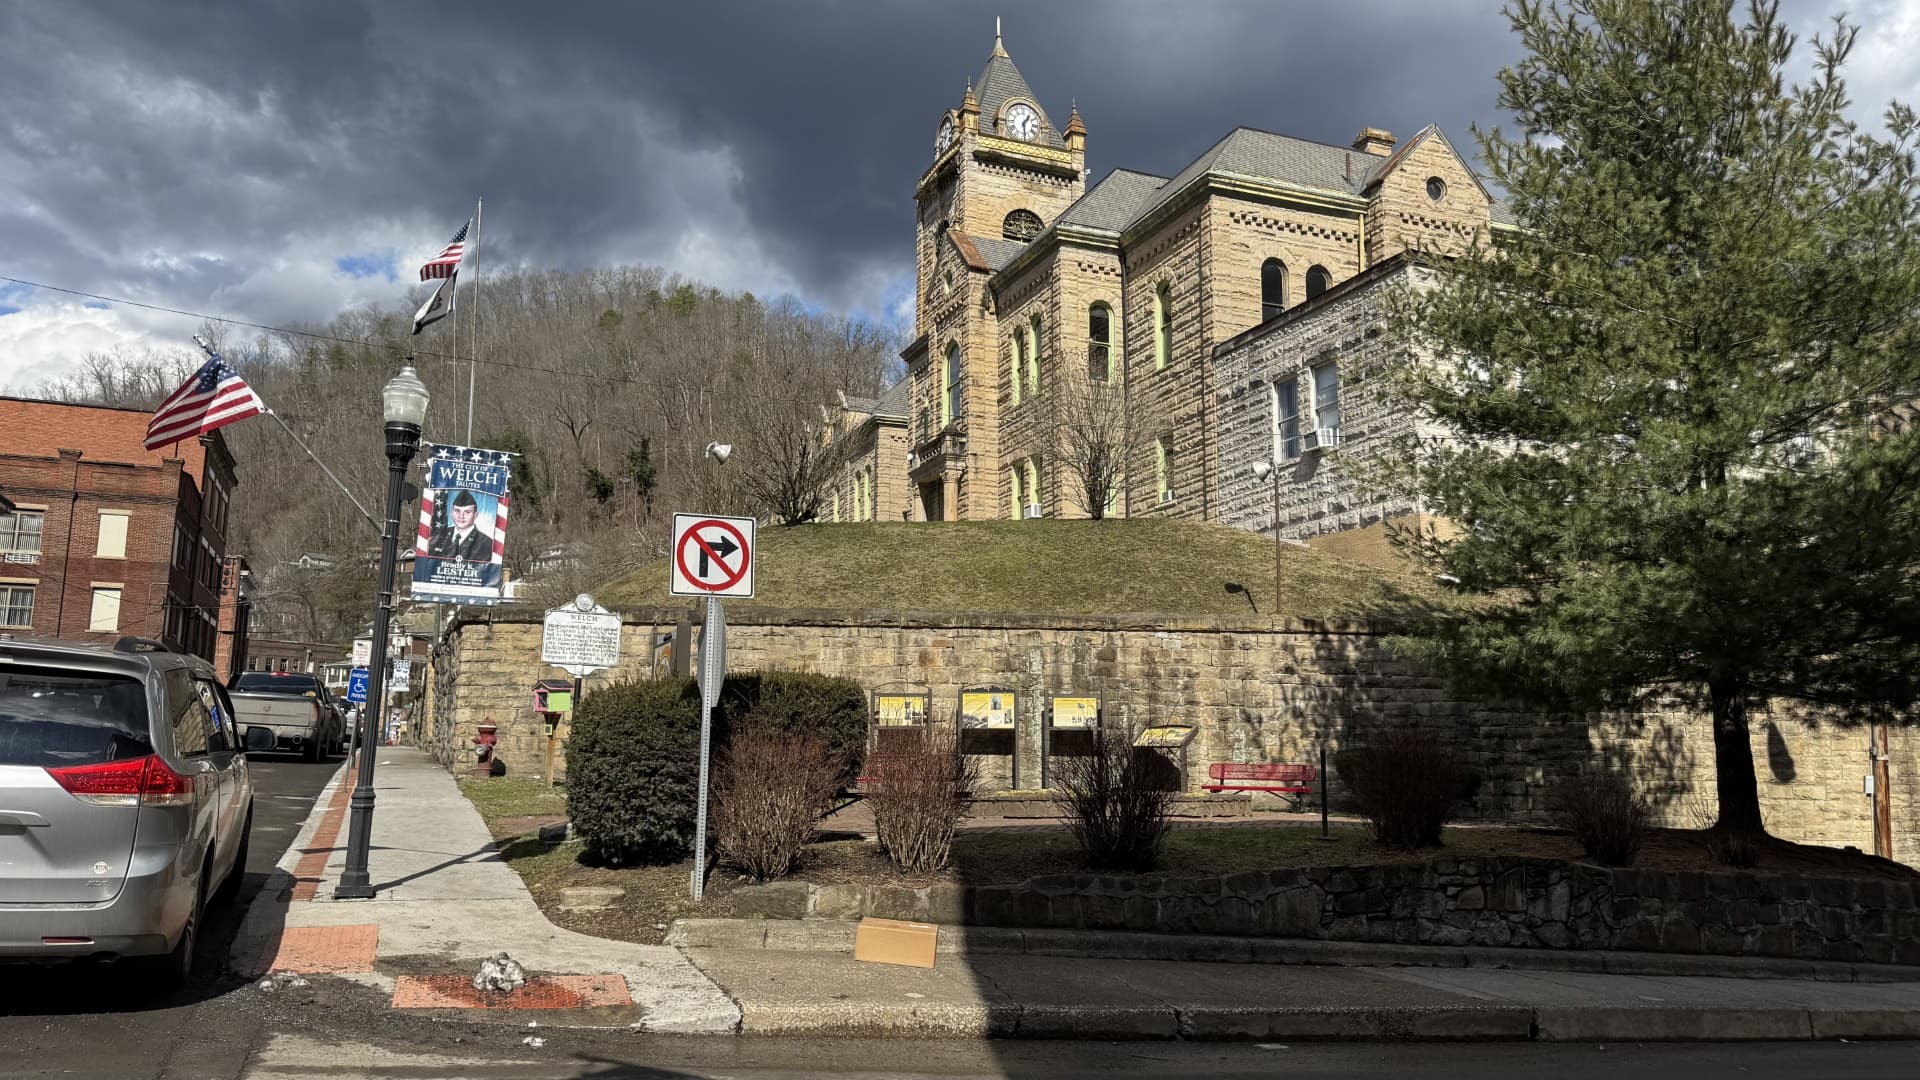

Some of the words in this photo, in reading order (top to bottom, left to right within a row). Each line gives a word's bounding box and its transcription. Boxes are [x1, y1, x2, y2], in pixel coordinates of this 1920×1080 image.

[465, 463, 480, 471] CITY
[440, 466, 498, 485] WELCH
[436, 566, 478, 578] LESTER
